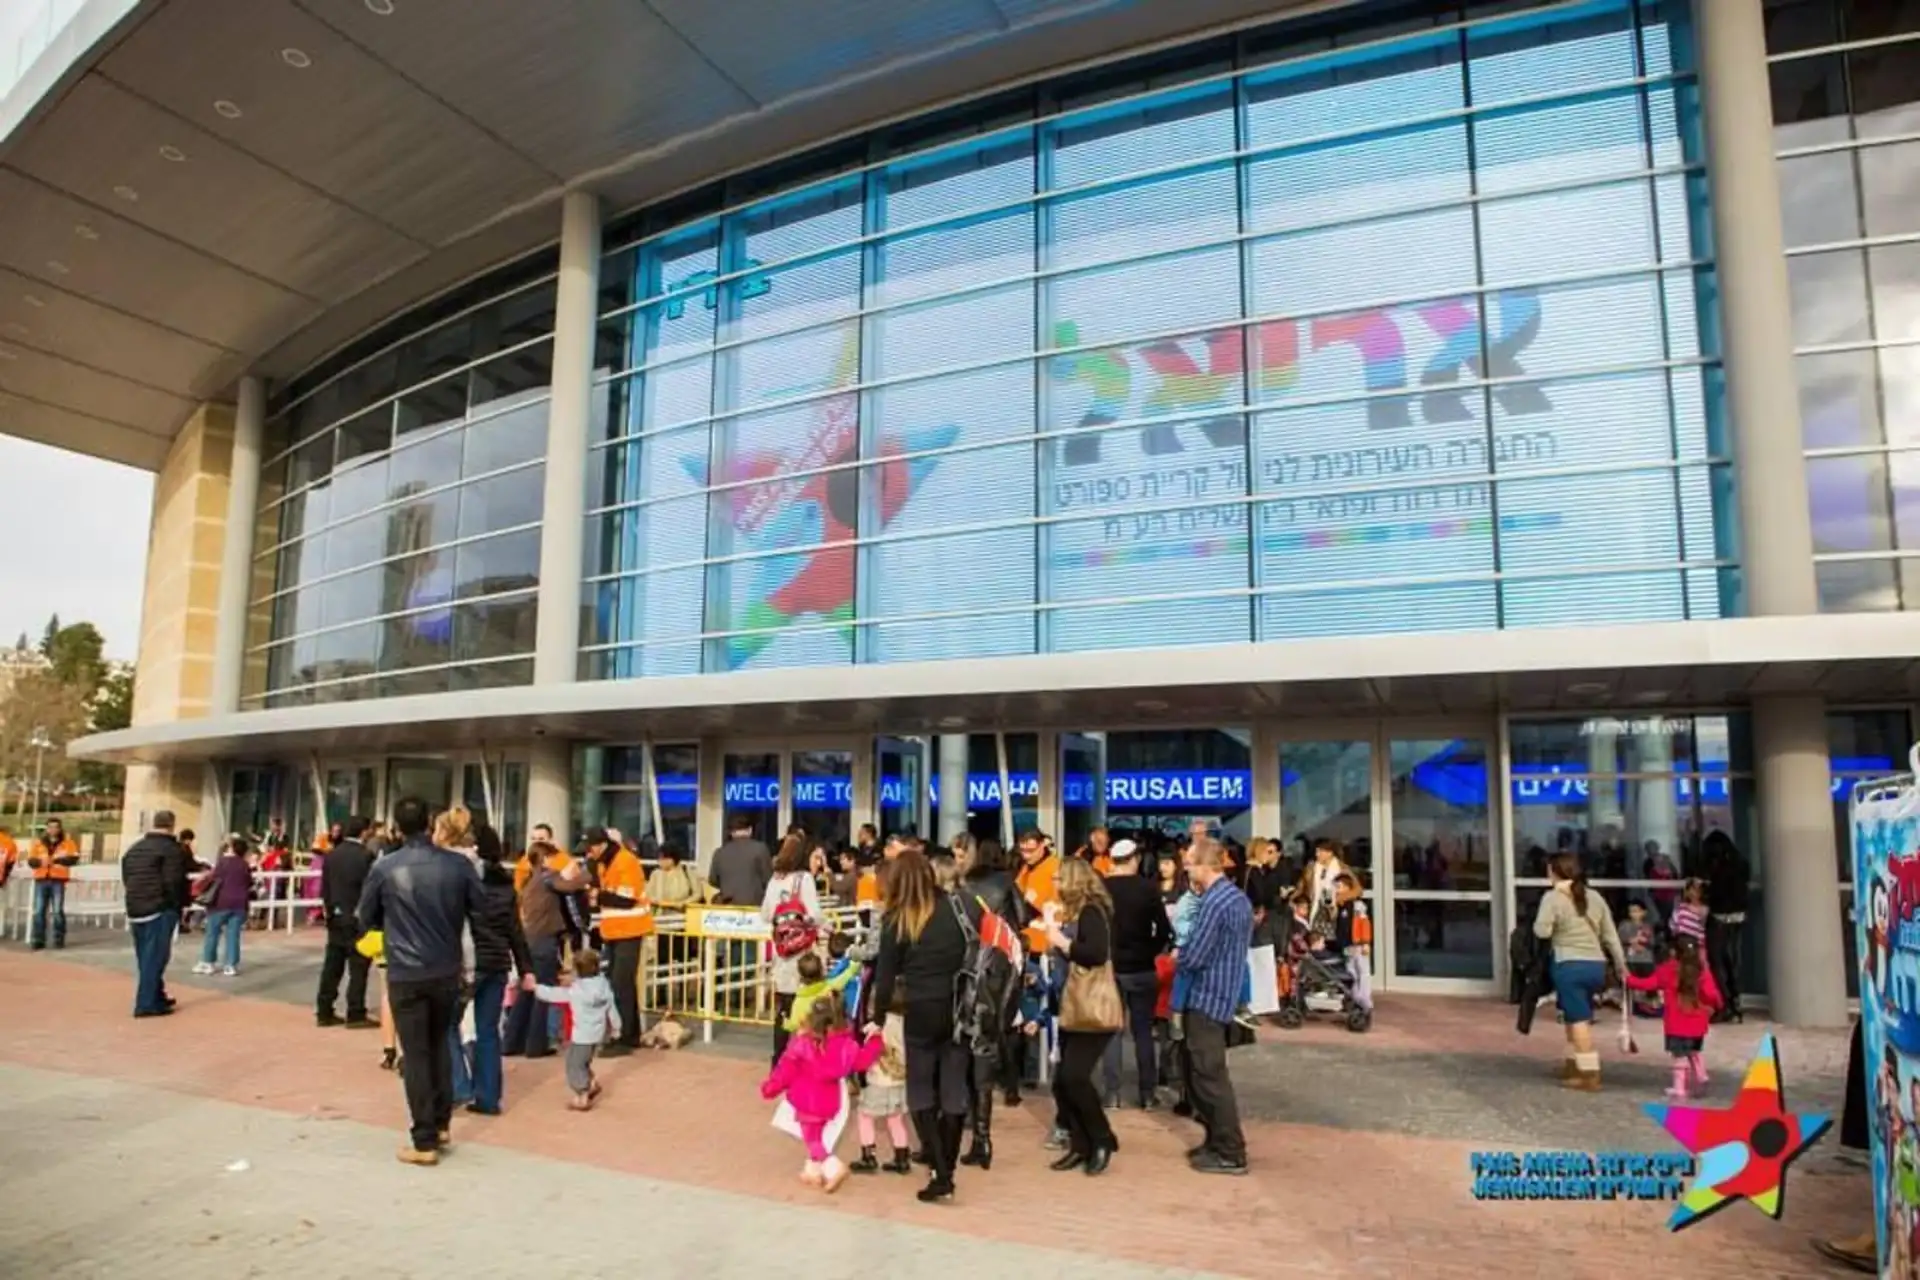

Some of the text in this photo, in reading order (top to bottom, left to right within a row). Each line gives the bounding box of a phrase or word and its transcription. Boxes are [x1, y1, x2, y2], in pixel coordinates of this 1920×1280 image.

[1219, 452, 1301, 490] לניול
[724, 782, 826, 802] WELCME
[1105, 776, 1244, 800] RUSALEM
